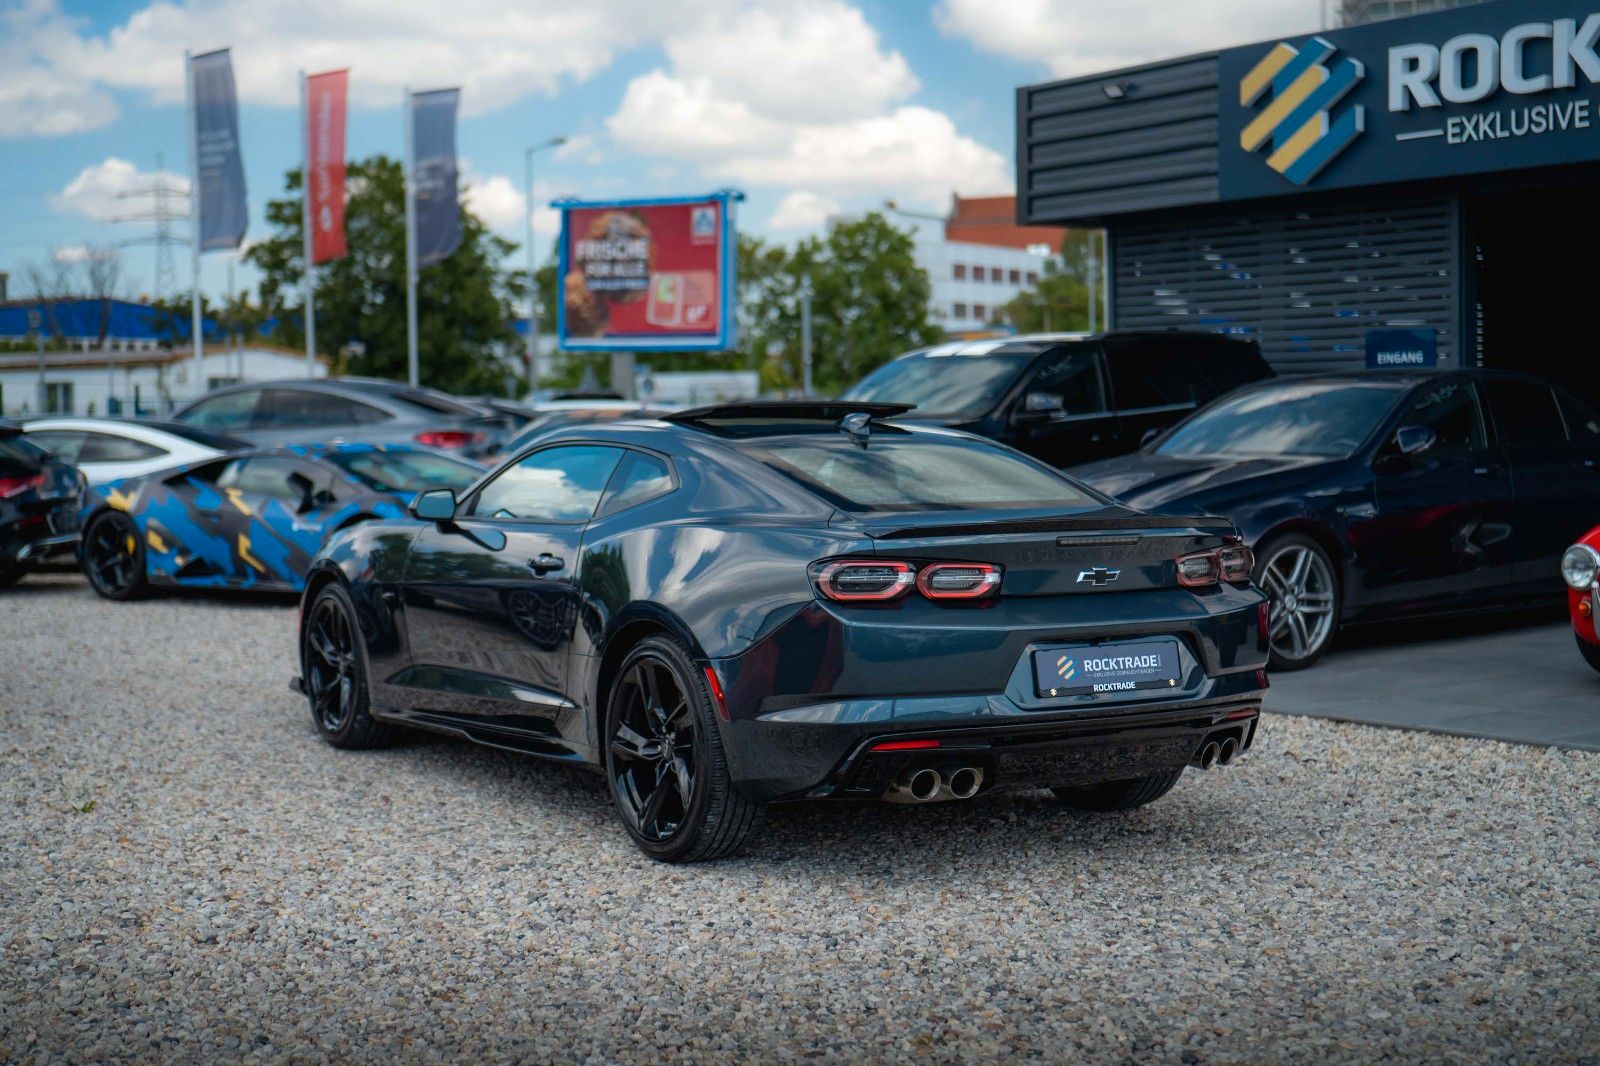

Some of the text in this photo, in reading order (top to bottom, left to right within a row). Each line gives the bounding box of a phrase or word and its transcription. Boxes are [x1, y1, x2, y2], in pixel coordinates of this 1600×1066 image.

[1388, 13, 1600, 111] ROCK
[1447, 99, 1590, 144] EXKLUSIVE
[1377, 350, 1424, 364] EINGANG
[1084, 655, 1157, 672] ROCKTRADE
[1093, 681, 1136, 692] ROCKTRADE
